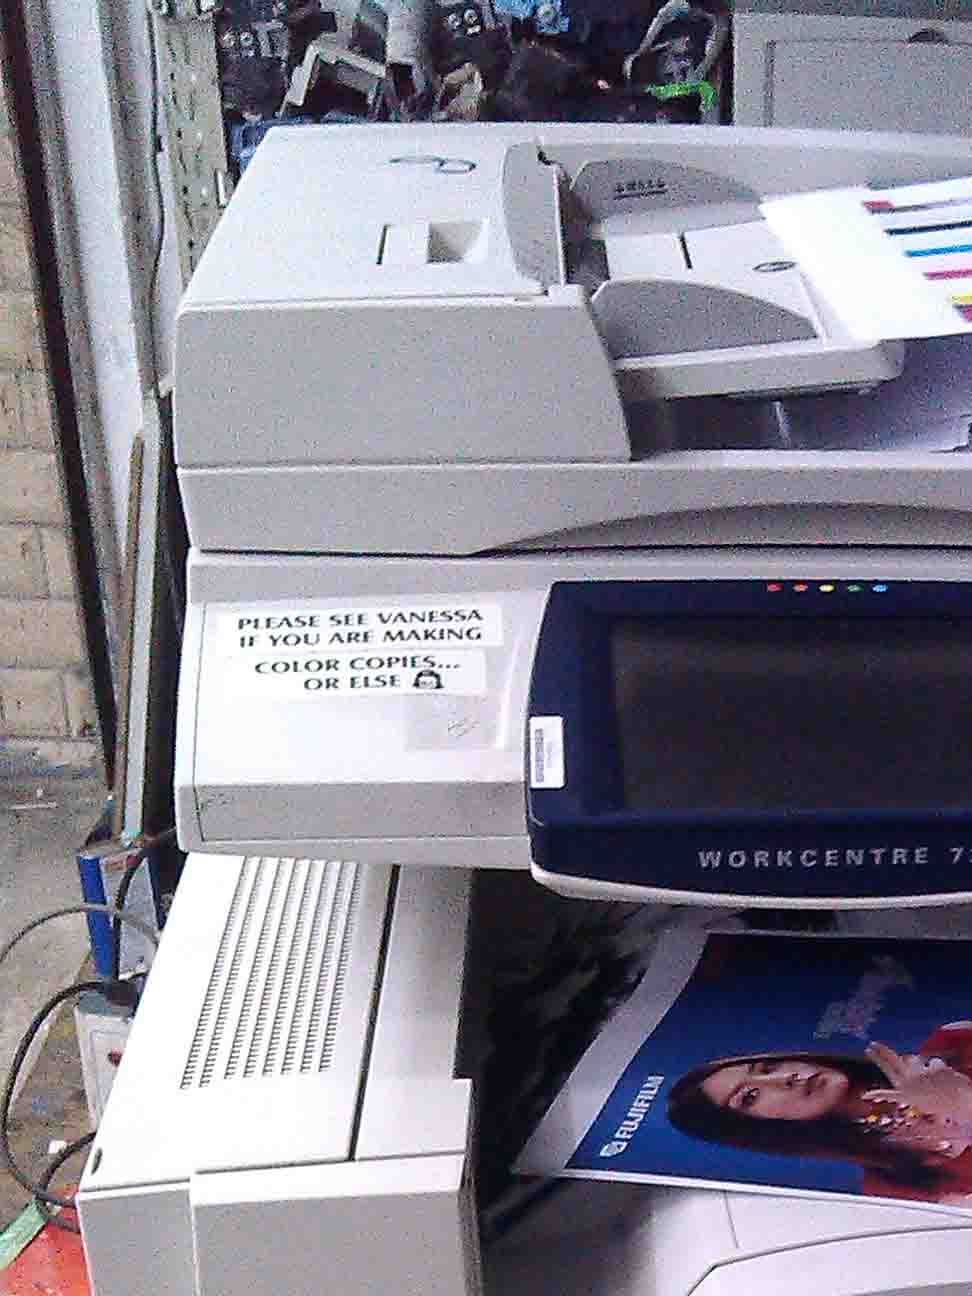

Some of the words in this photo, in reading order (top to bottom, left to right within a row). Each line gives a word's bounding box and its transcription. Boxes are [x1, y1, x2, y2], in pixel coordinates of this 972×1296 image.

[237, 615, 321, 630] PLEASE
[328, 612, 369, 627] SEE
[378, 609, 484, 624] VANESSA
[239, 635, 258, 649] IF
[269, 633, 321, 648] YOU
[328, 631, 374, 645] ARE
[383, 627, 483, 642] MAKING
[254, 658, 341, 674] COLOR
[303, 677, 340, 691] OR
[350, 674, 401, 690] ELSE
[698, 847, 929, 868] WORKCENTRE
[615, 1075, 665, 1140] FUJIFILM
